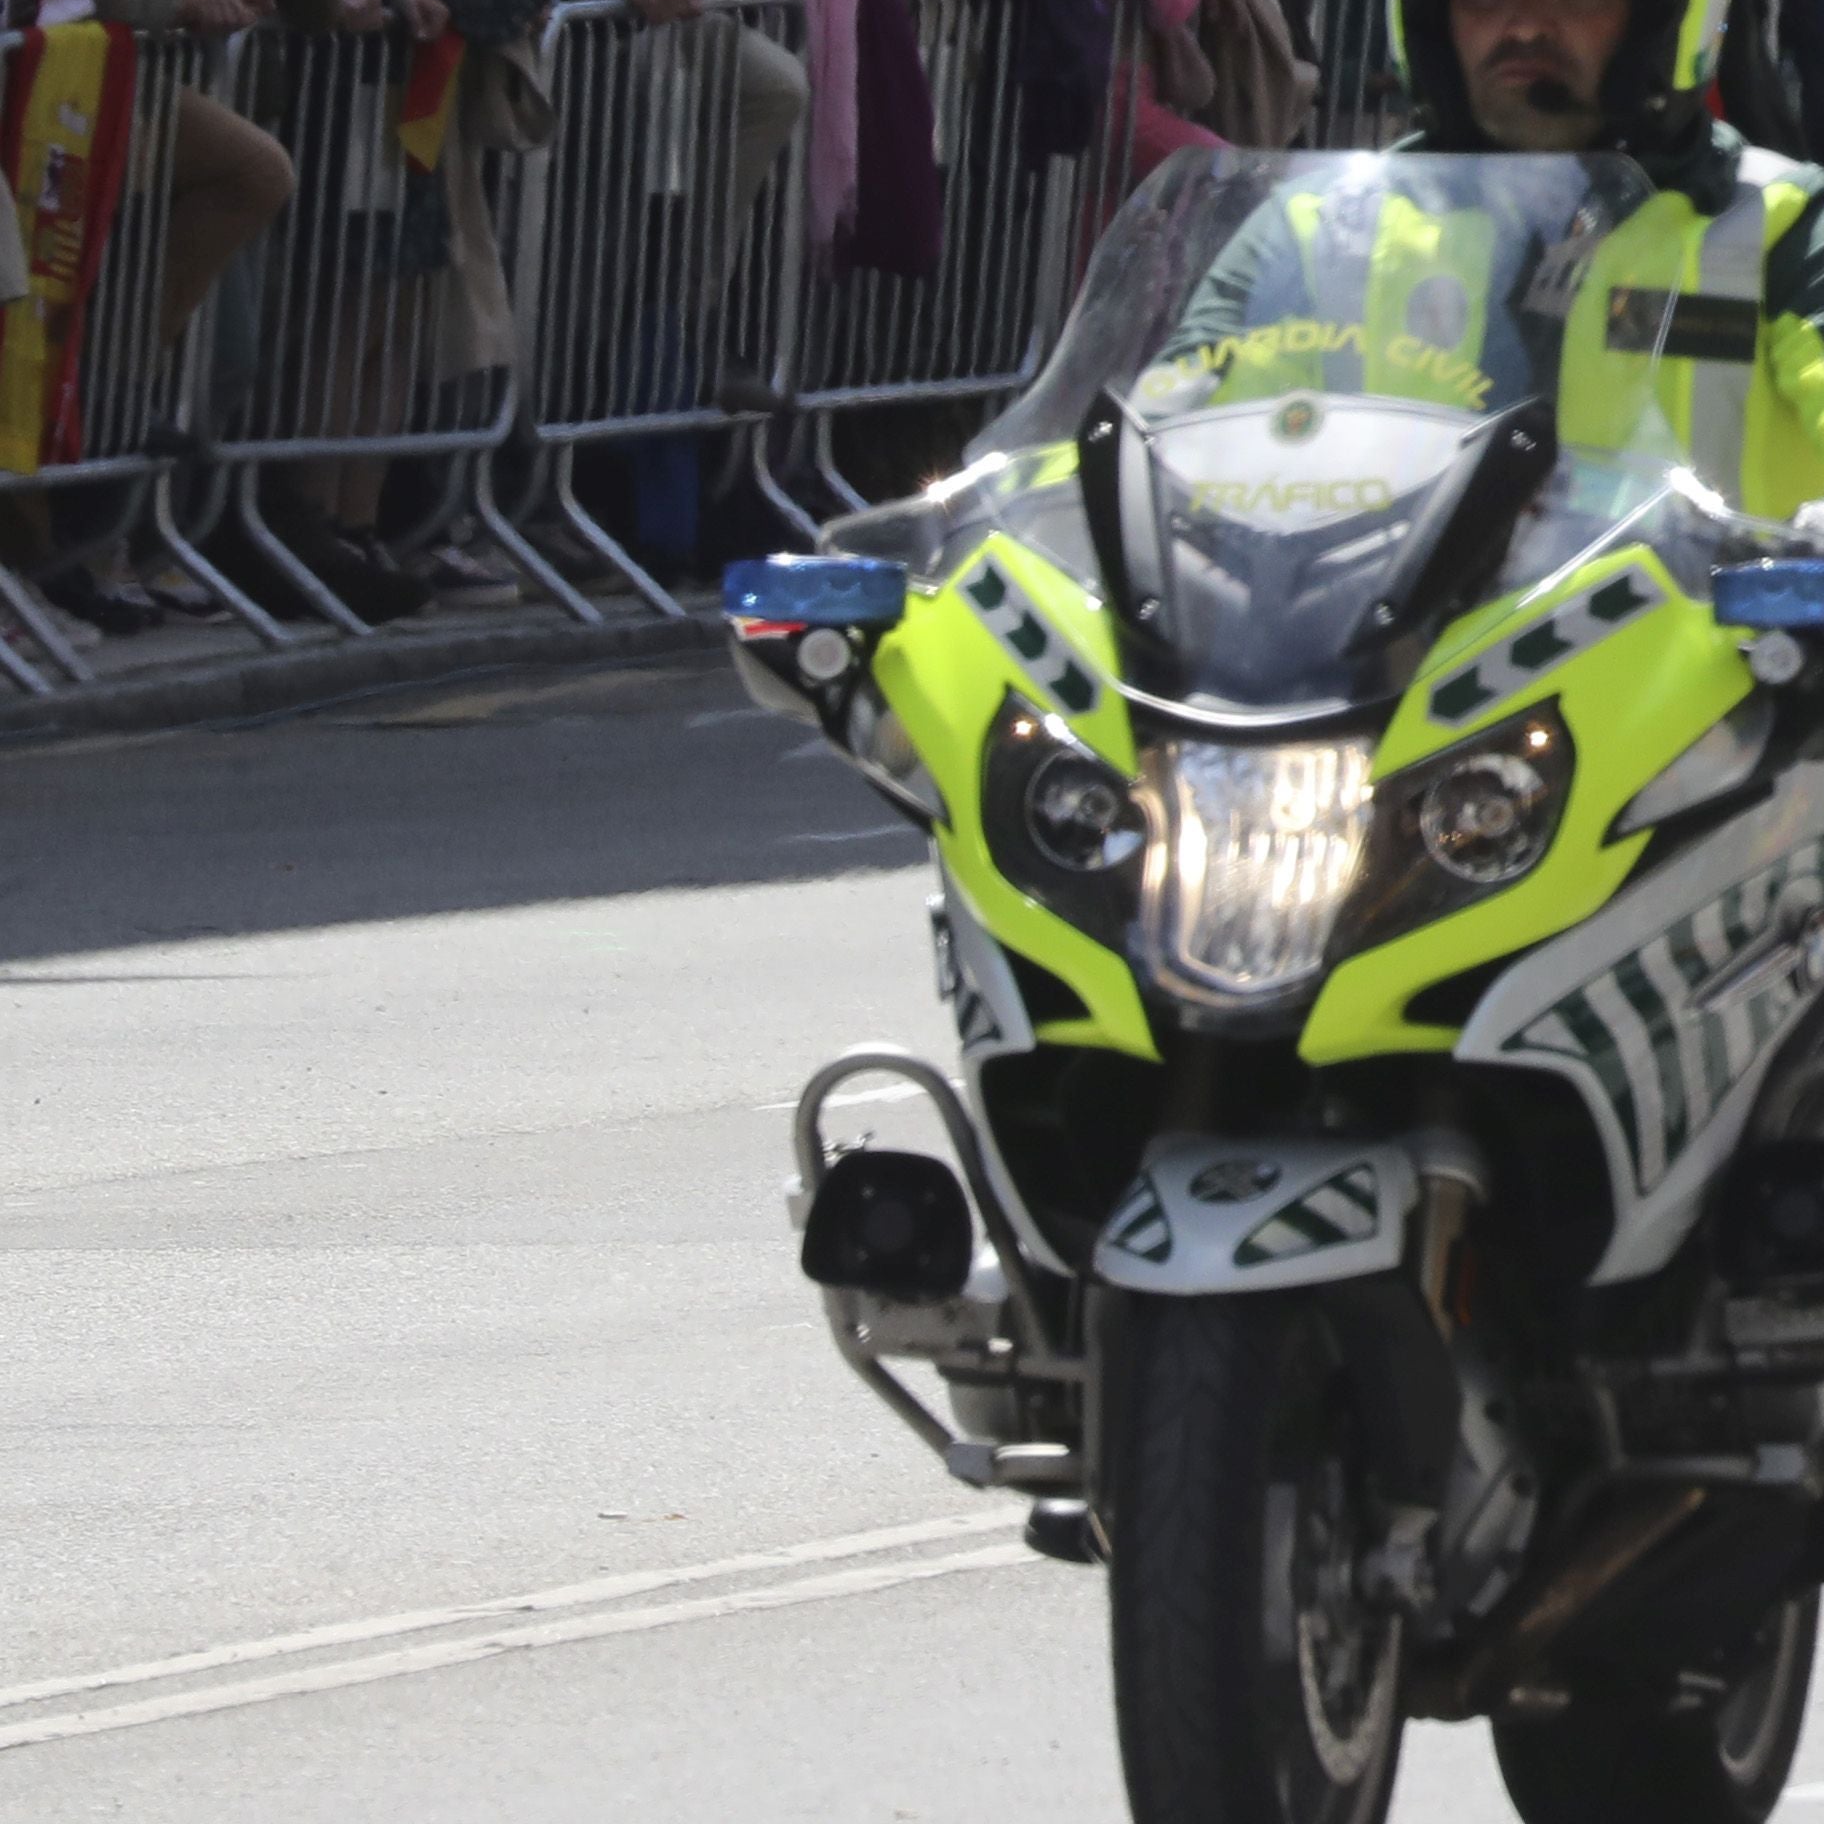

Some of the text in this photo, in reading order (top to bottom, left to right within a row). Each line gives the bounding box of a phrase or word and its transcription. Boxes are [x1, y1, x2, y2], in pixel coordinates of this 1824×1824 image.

[1142, 319, 1495, 410] GUARDIA CIVIL
[1188, 474, 1392, 512] TRÁFICO
